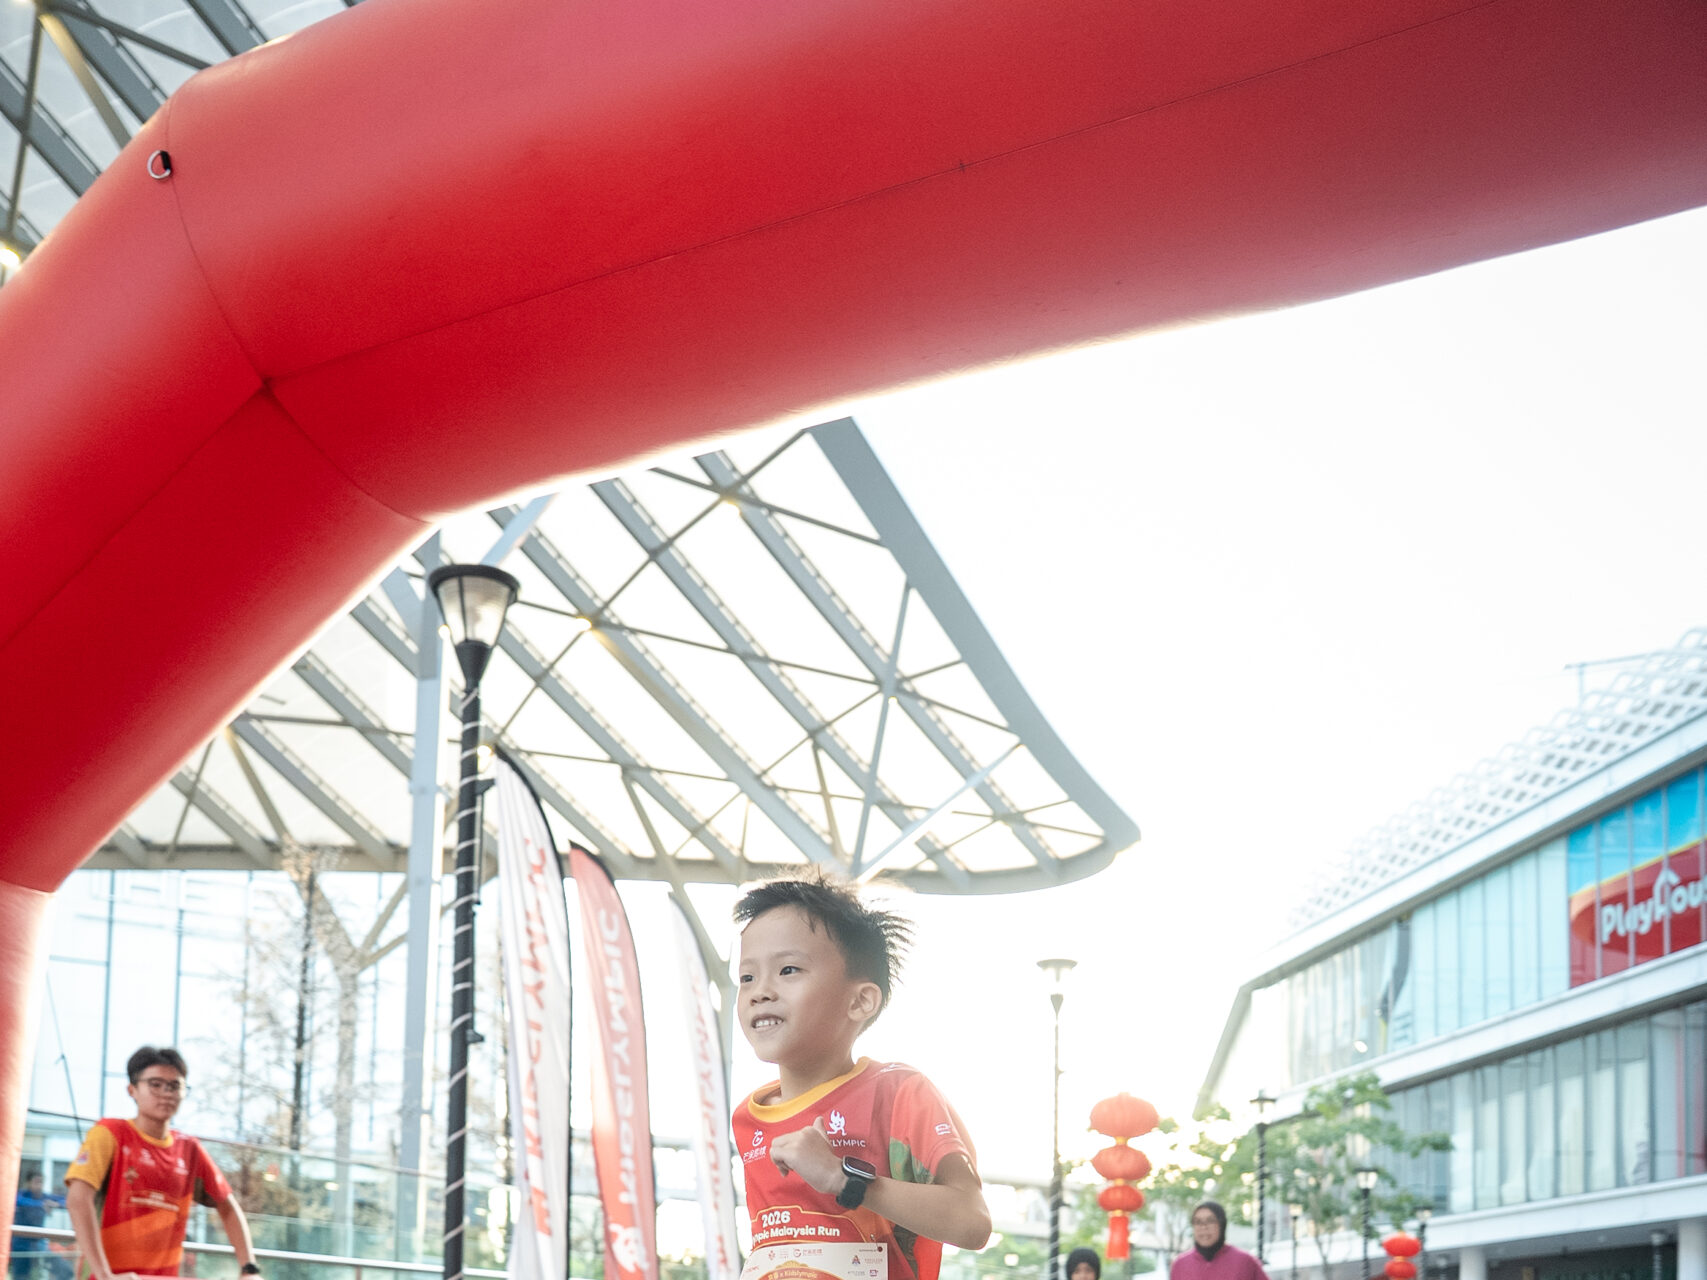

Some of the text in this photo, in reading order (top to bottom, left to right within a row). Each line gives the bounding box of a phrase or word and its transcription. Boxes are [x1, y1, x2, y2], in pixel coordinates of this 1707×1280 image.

[831, 1139, 867, 1148] LYMPIC
[761, 1211, 791, 1229] 2026
[770, 1224, 816, 1239] Malaysia
[817, 1225, 841, 1237] Run
